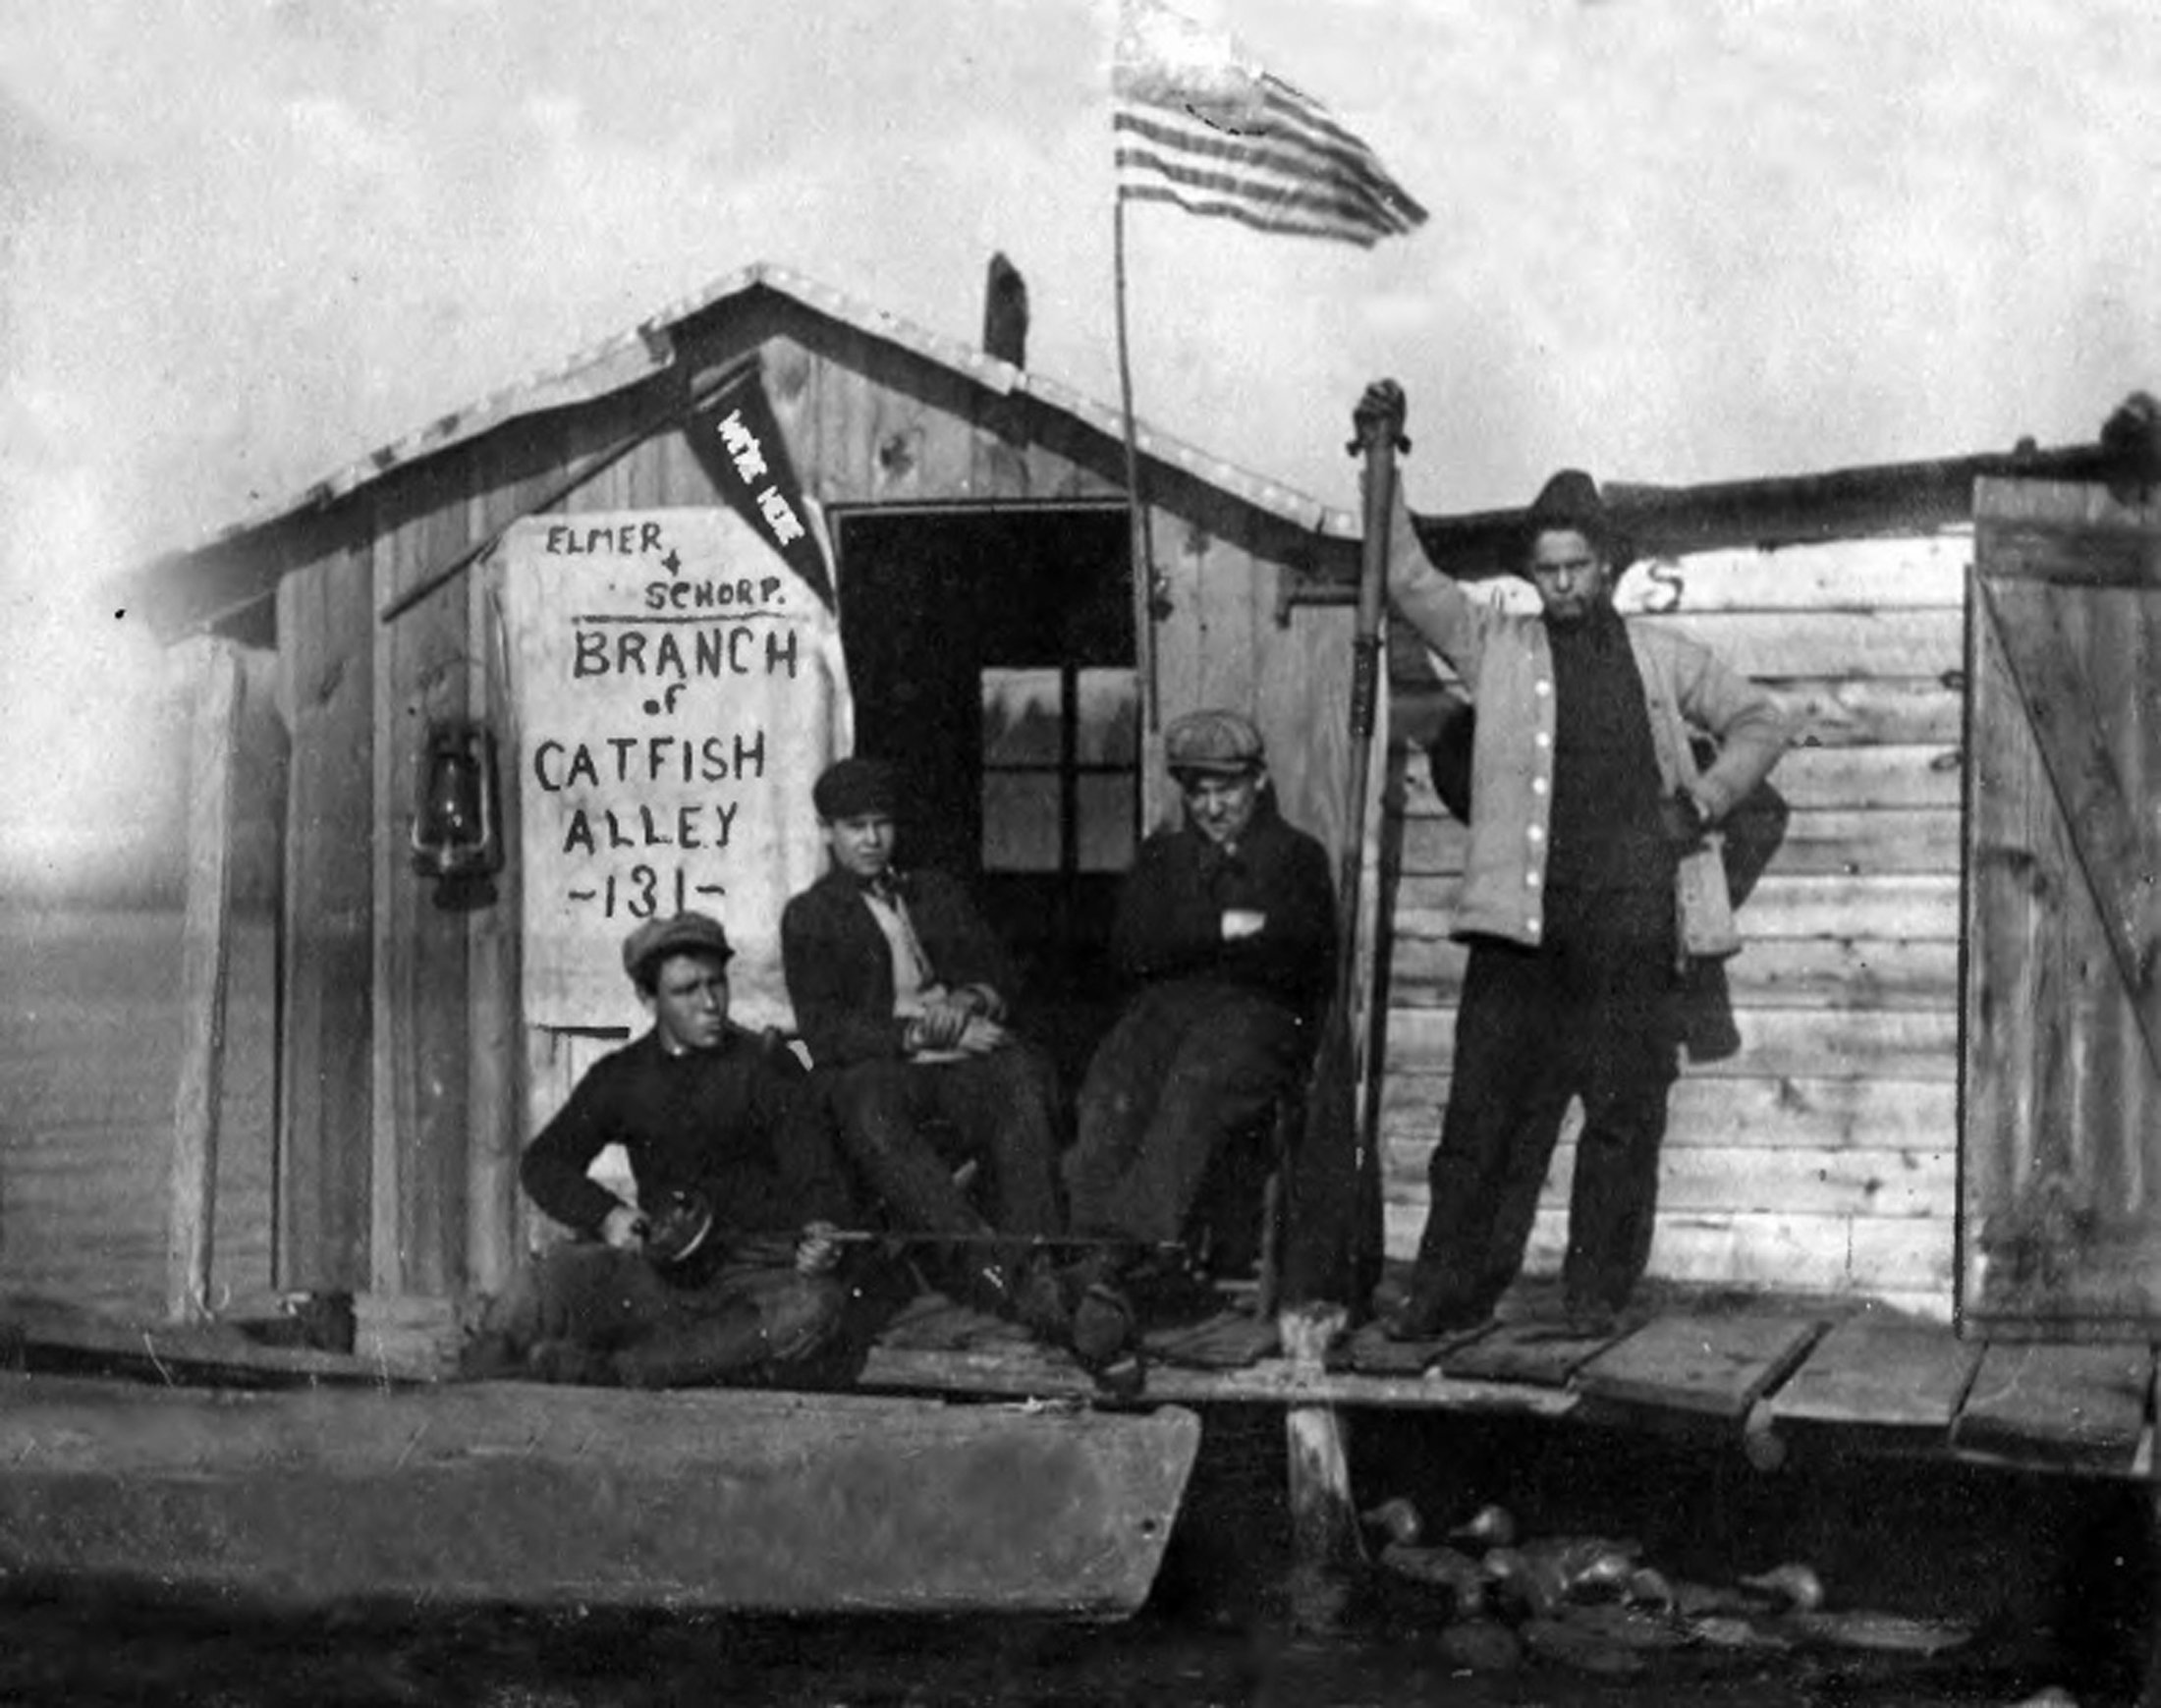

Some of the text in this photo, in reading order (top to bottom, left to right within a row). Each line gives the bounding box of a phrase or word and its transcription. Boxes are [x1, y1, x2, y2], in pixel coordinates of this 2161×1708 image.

[545, 522, 662, 556] ELMER
[573, 626, 798, 680] BRANCH
[532, 729, 765, 793] CATFISH
[562, 800, 739, 855] ALLEY
